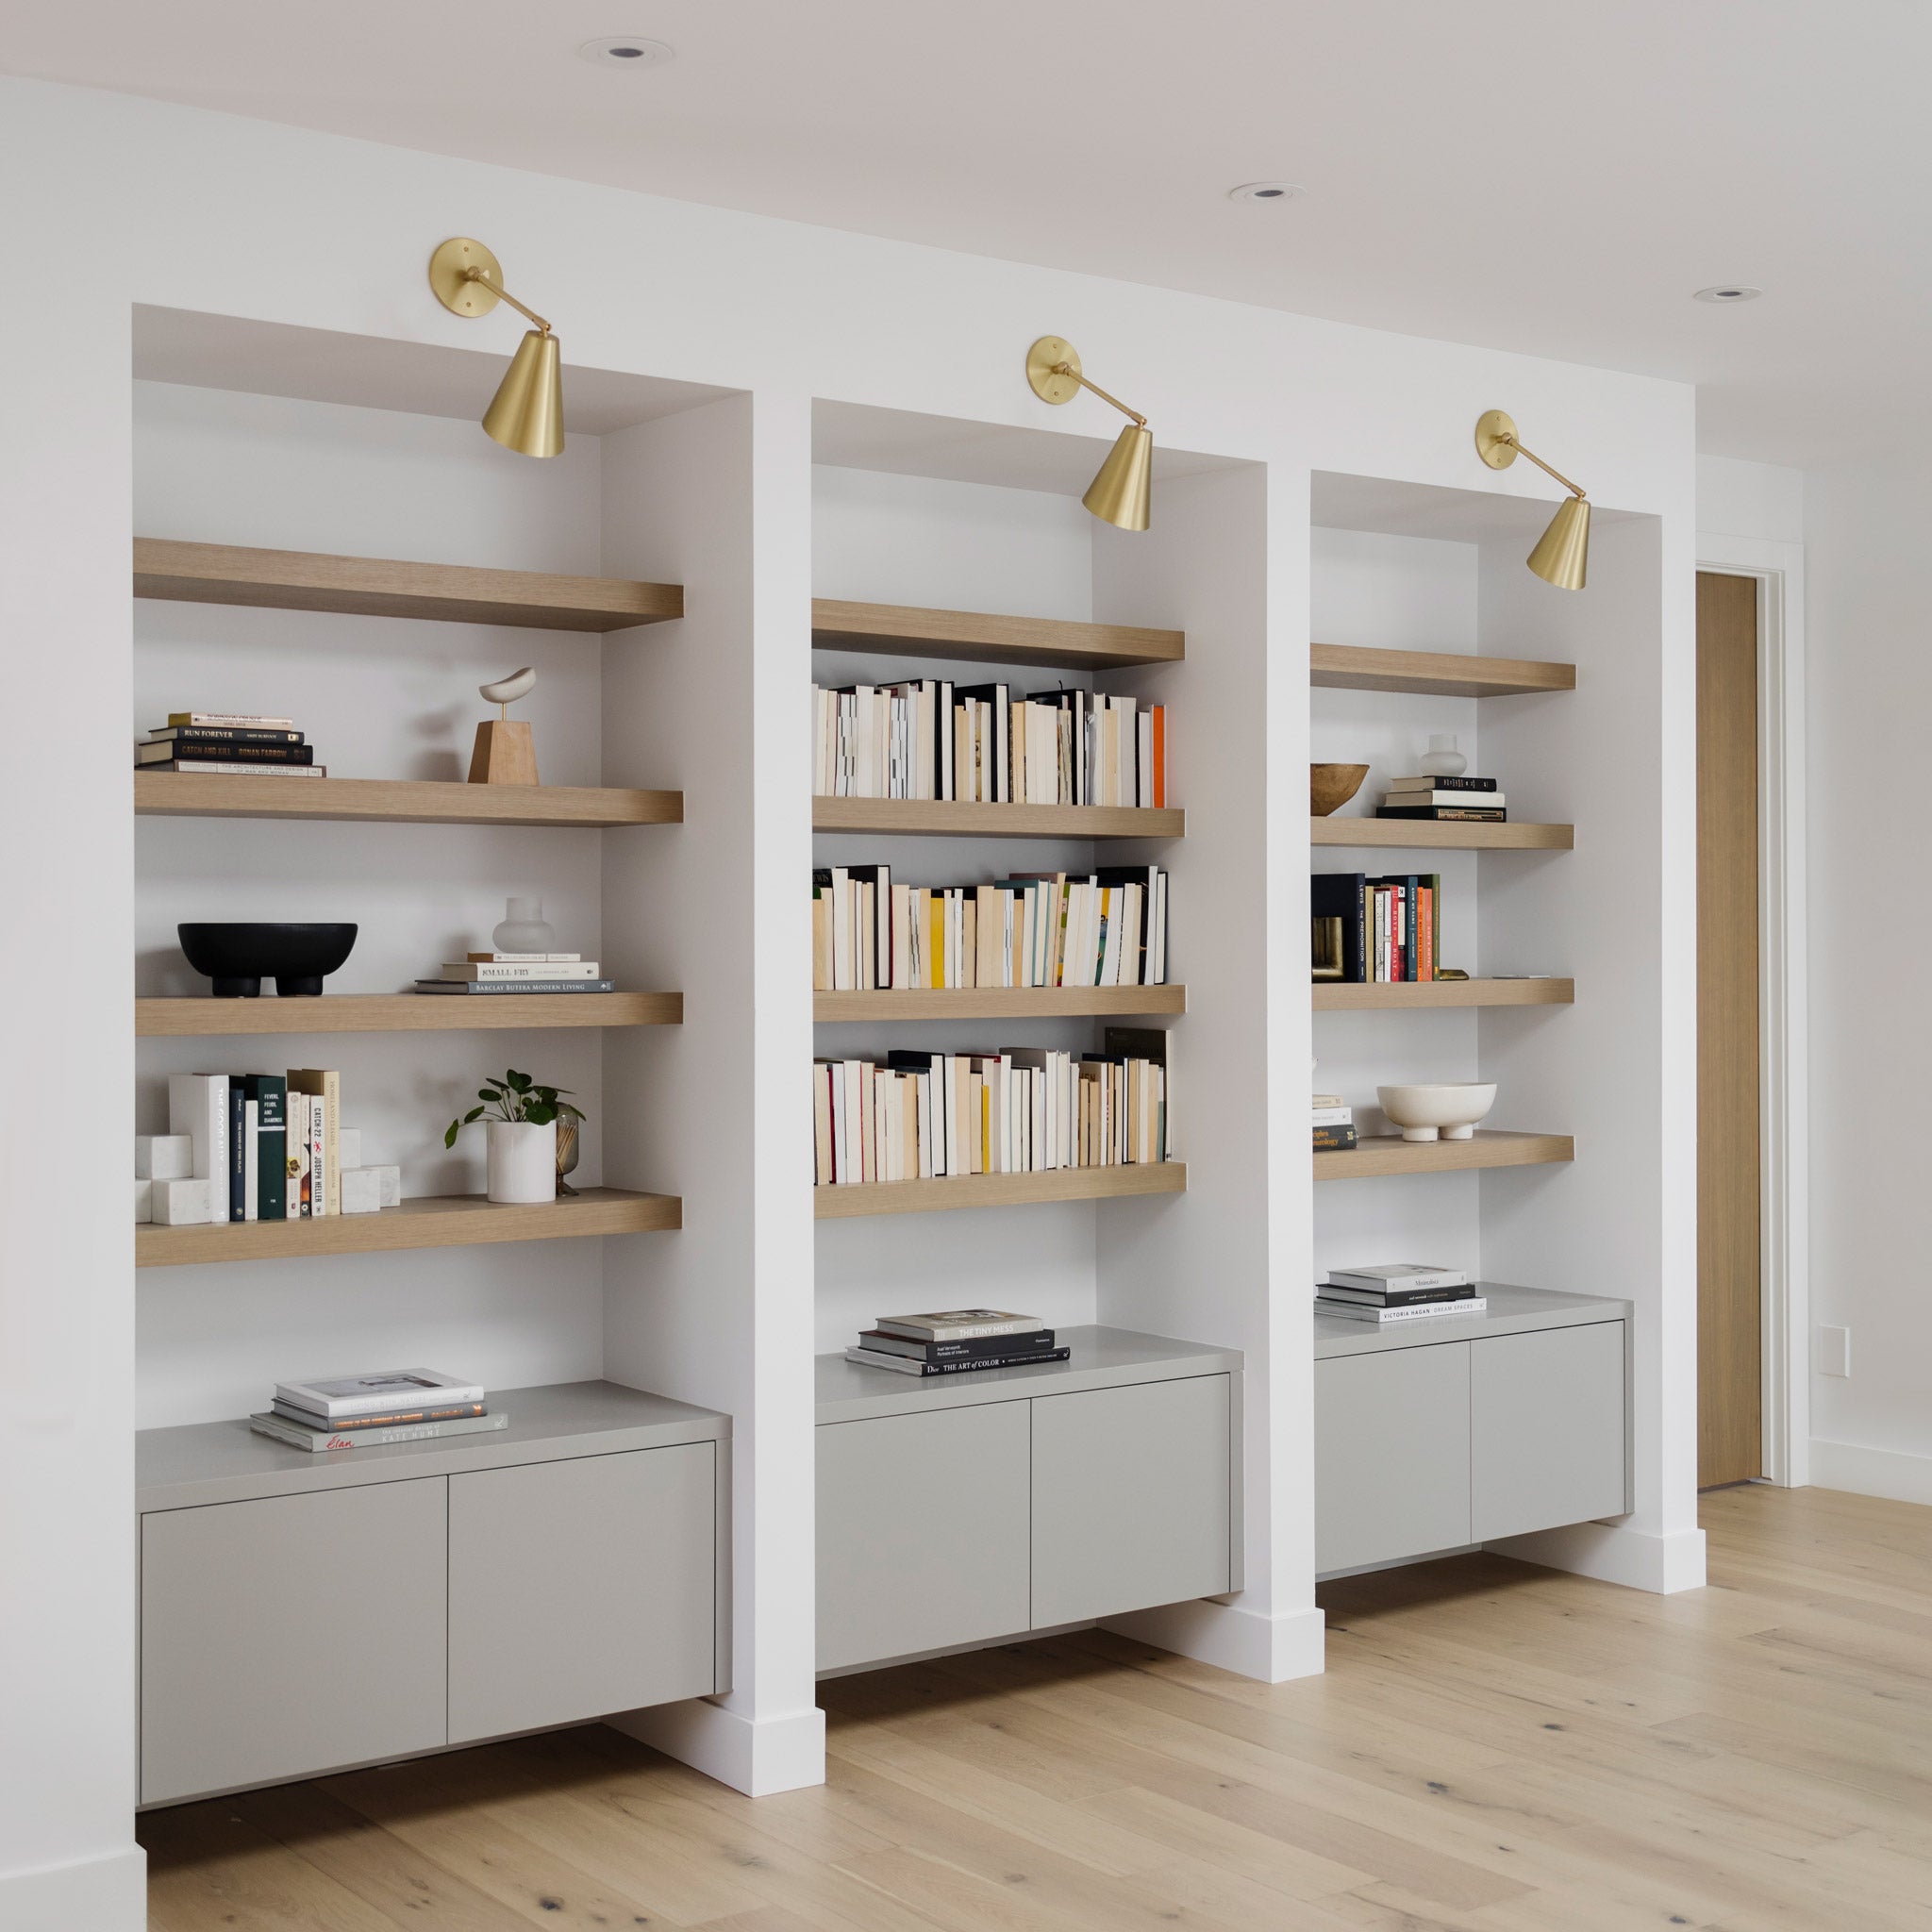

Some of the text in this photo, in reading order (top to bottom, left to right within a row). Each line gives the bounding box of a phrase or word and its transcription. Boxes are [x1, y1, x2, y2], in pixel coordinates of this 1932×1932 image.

[1384, 1310, 1409, 1319] VICTORIA
[958, 1324, 1014, 1337] THE TINY MESS
[958, 1362, 971, 1371] ART
[972, 1361, 978, 1370] of
[977, 1358, 1000, 1368] COLOR
